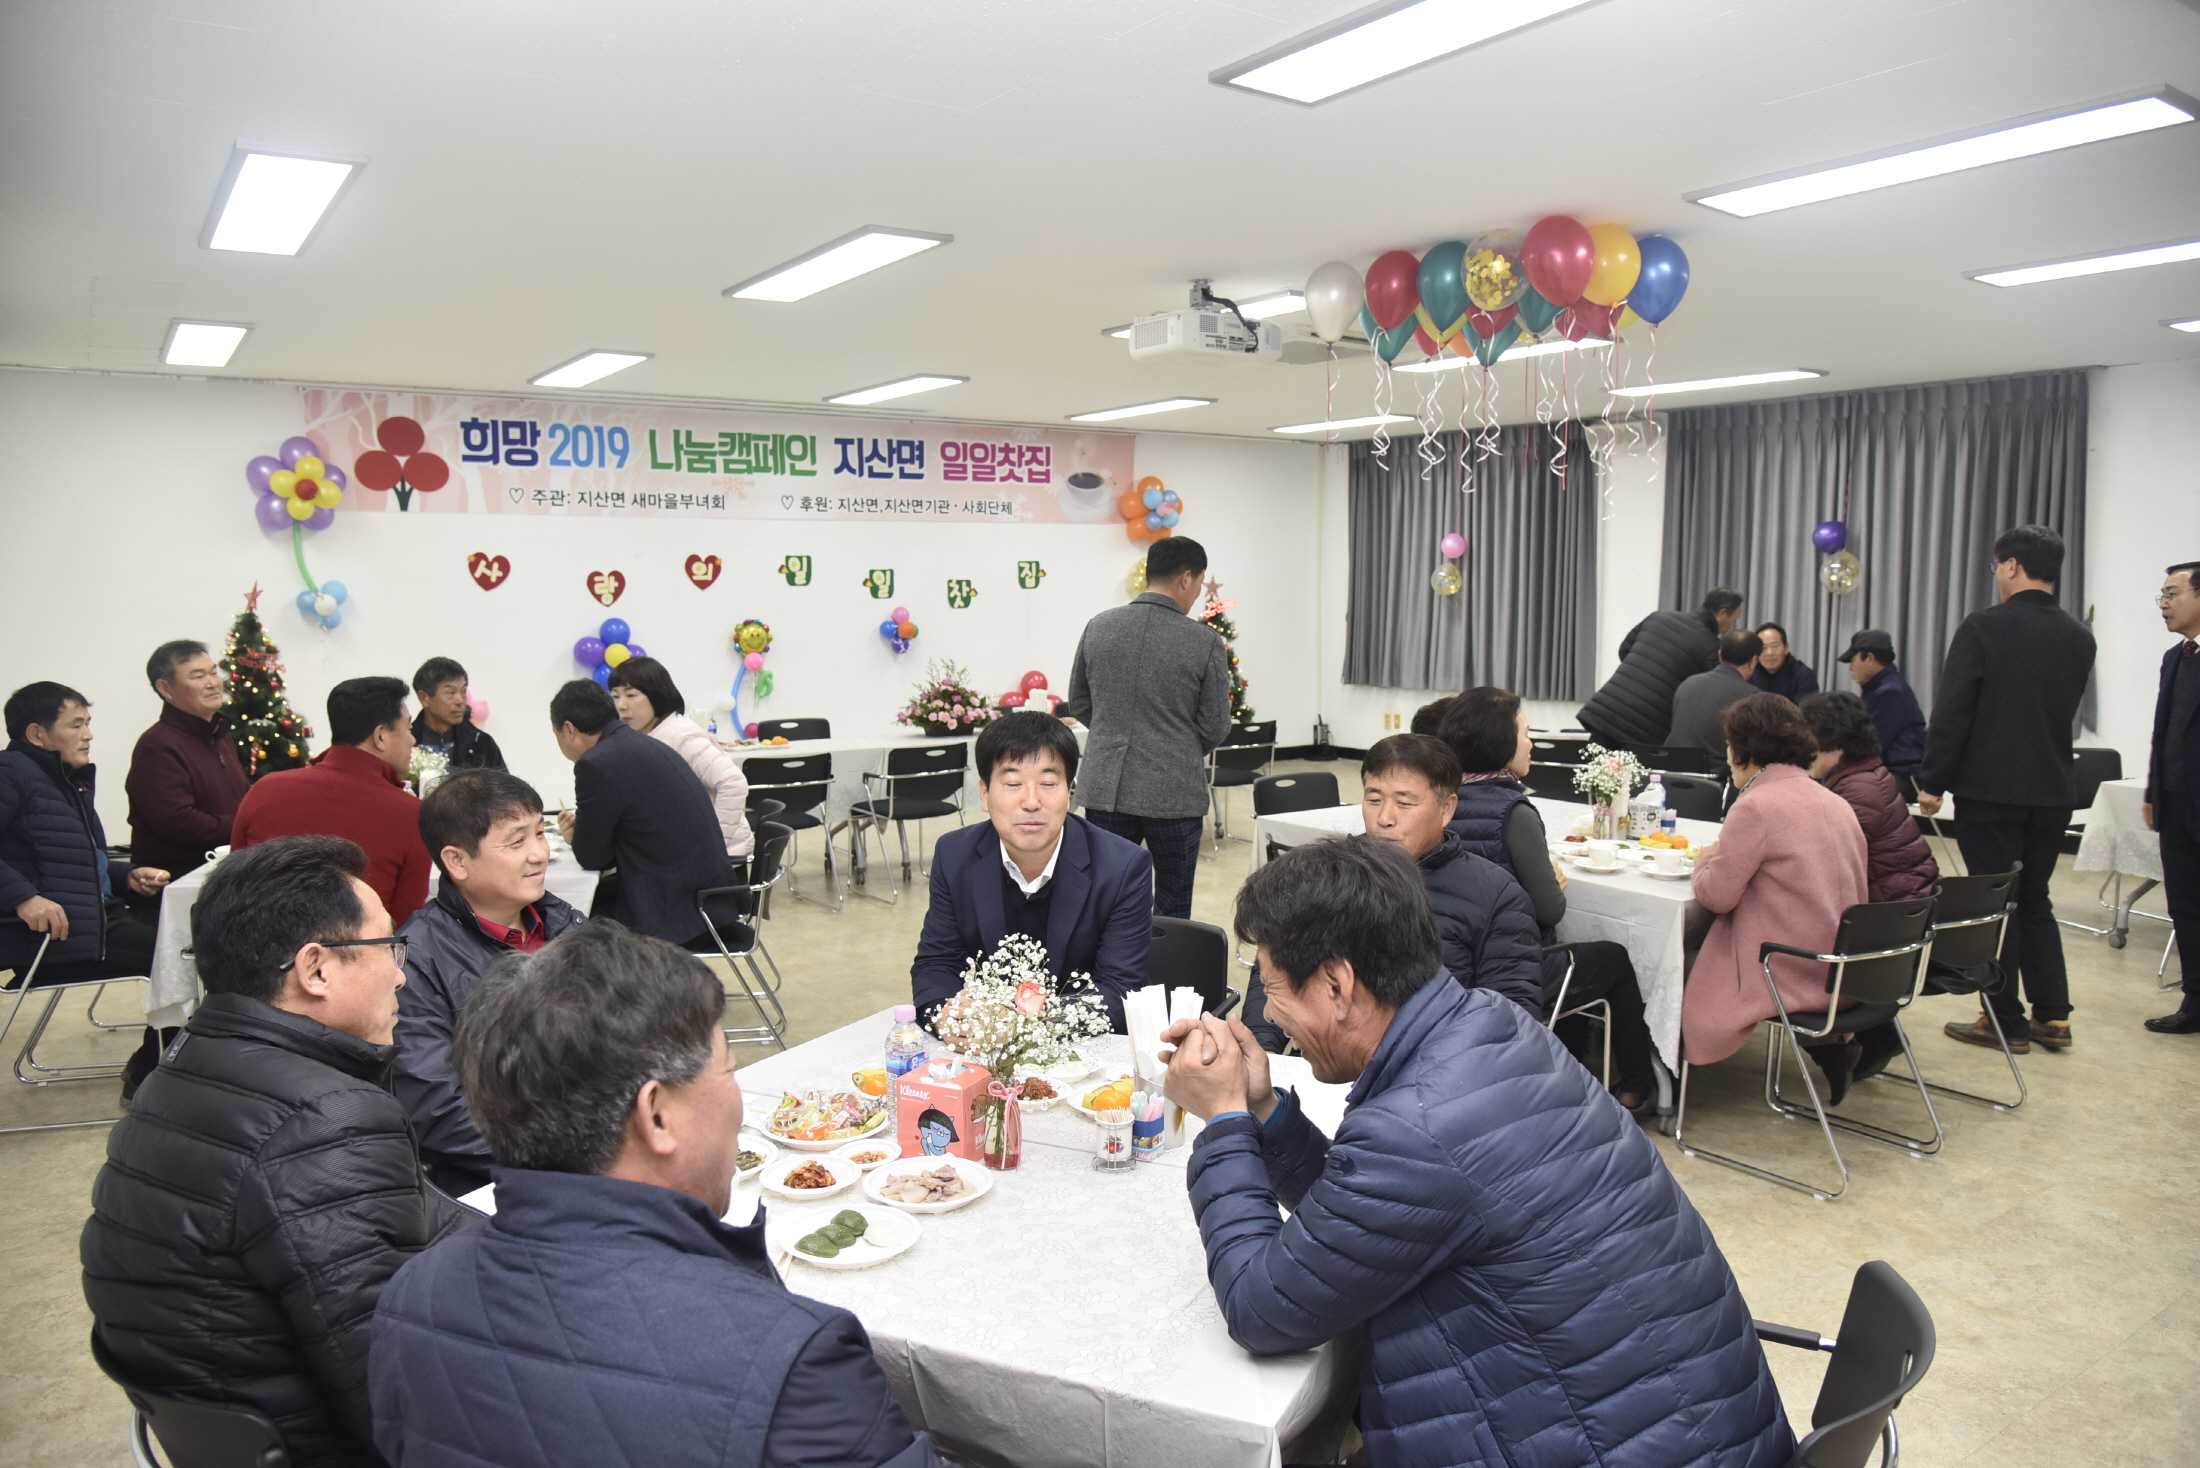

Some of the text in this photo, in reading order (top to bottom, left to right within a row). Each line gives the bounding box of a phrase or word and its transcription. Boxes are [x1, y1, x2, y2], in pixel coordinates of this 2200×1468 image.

[460, 417, 1051, 484] 희망 2019 나눔캠페인 지산면 일일찻집
[531, 488, 726, 511] 주관: 지산면 새마을부녀회
[799, 496, 833, 513] 후원:
[962, 500, 1013, 516] 사회단체
[474, 559, 503, 583] 사
[593, 575, 618, 606] 랑
[691, 561, 714, 581] 의
[787, 556, 807, 585] 일
[872, 570, 891, 598] 일
[1019, 562, 1037, 588] 집
[900, 1084, 931, 1101] Kleenex
